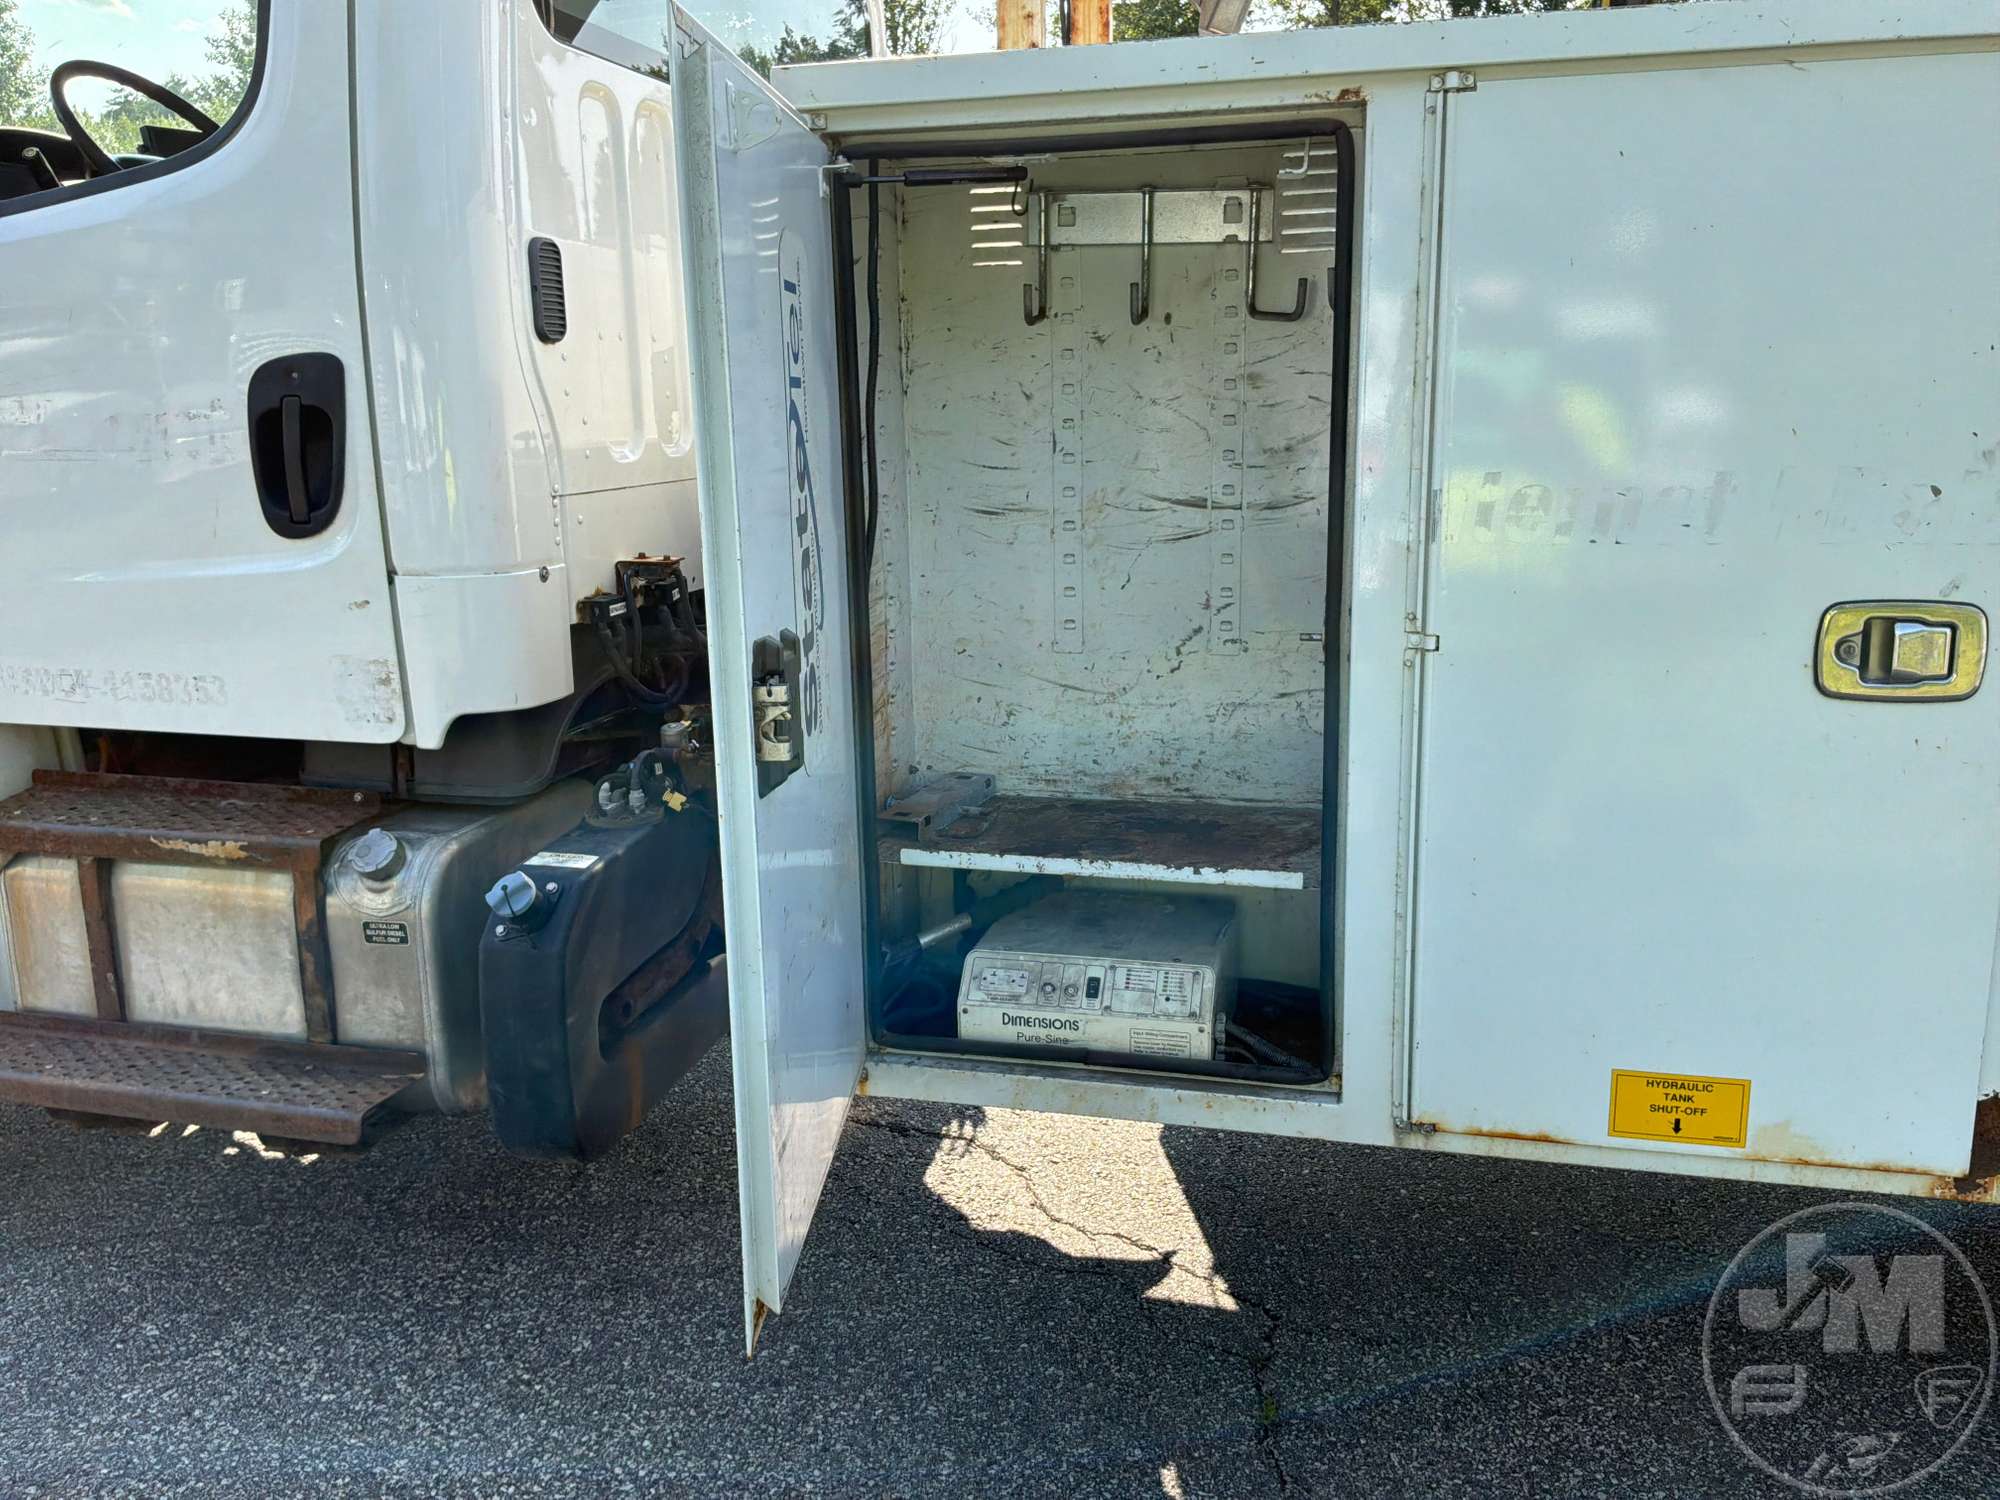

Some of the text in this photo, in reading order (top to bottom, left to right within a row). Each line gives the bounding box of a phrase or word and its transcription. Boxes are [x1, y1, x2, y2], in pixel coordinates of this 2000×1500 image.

[1646, 1079, 1714, 1093] HYDRAULIC
[1663, 1092, 1695, 1103] TANK
[1649, 1103, 1708, 1116] SHUT-OFF
